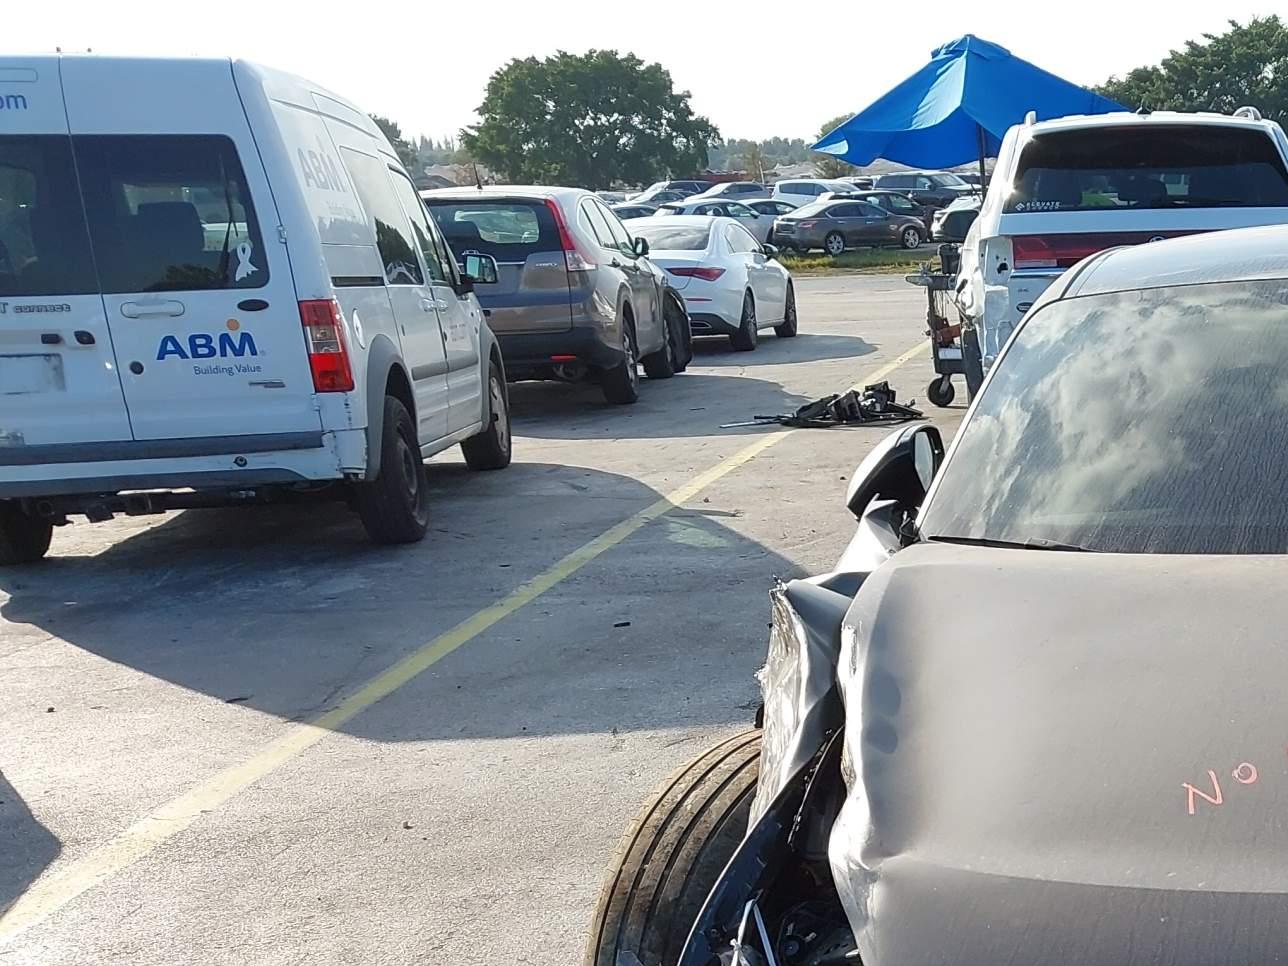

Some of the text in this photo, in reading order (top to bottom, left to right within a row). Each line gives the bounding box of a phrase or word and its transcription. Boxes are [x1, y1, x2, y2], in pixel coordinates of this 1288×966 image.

[297, 147, 346, 193] ABM
[156, 332, 258, 361] ABM
[193, 363, 262, 376] Building Value
